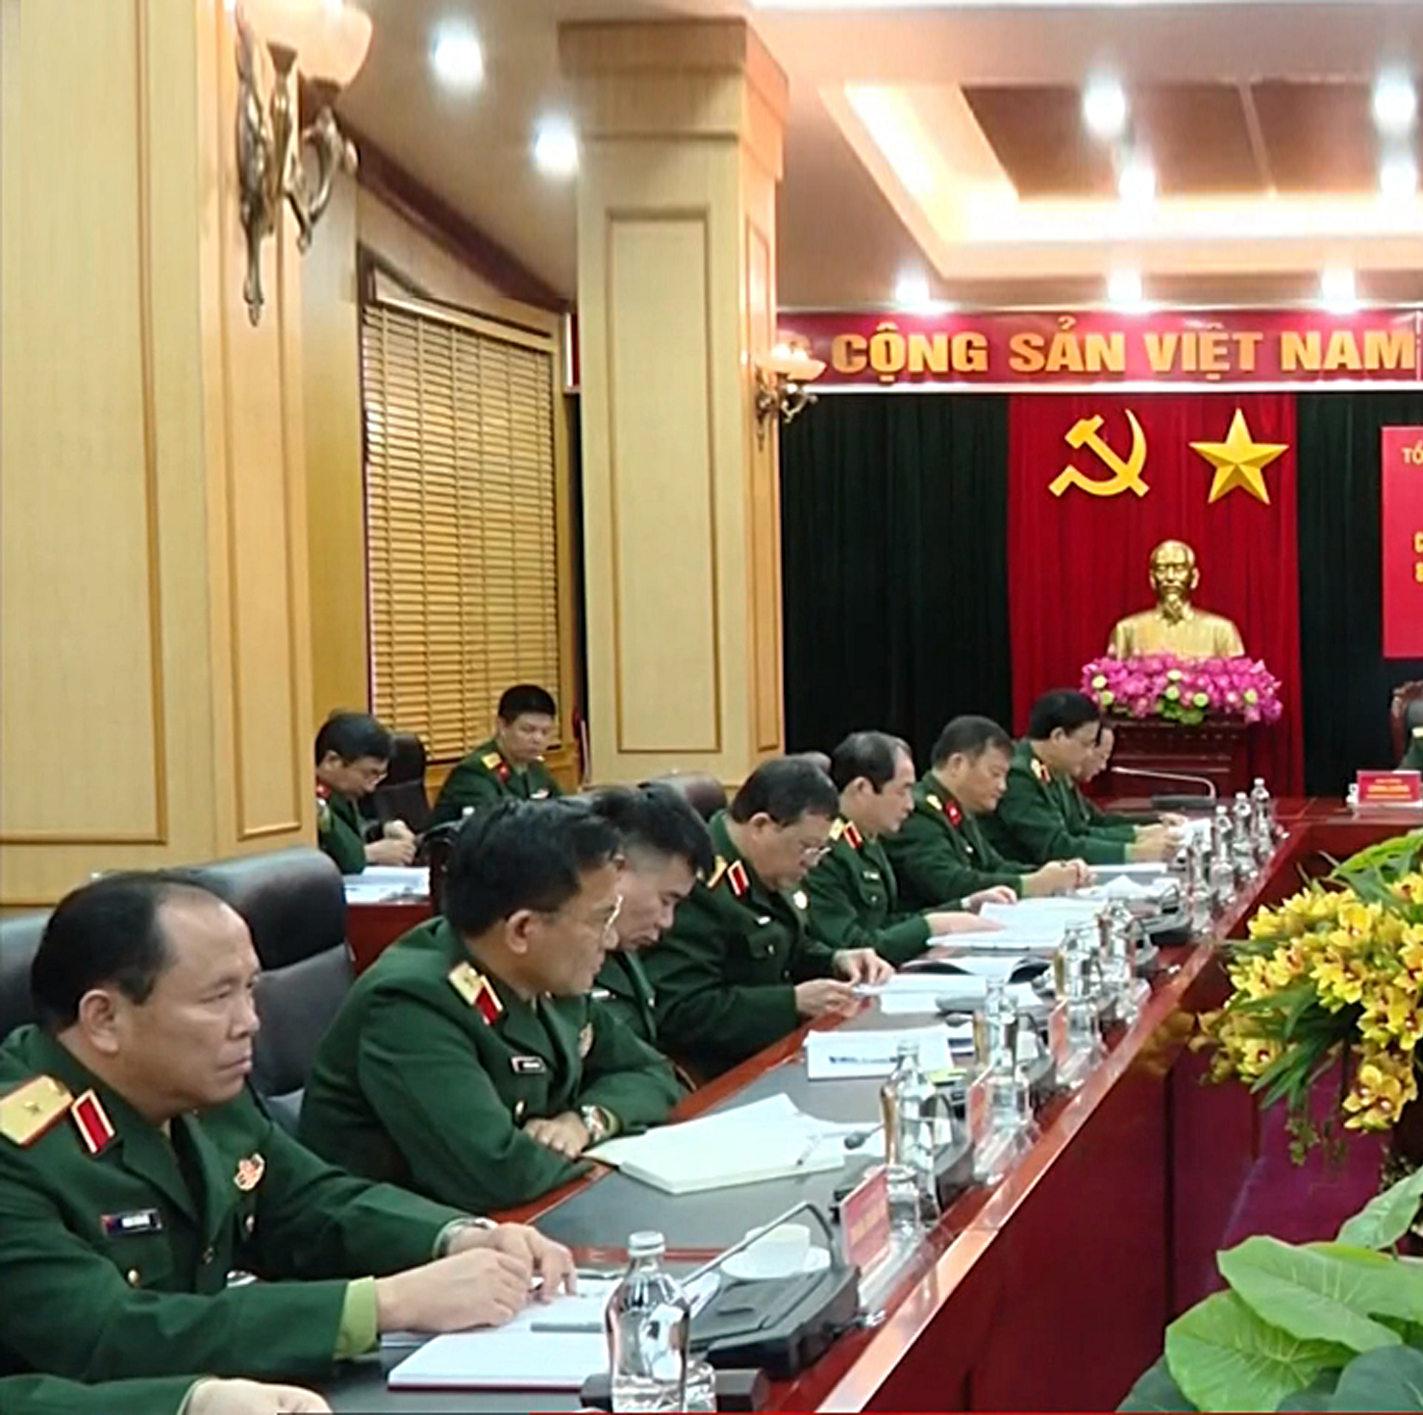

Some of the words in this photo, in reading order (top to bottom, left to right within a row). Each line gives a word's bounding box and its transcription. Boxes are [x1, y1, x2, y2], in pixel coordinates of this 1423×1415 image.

[831, 321, 989, 382] CỘNG
[1009, 316, 1125, 373] SẢN
[1144, 321, 1263, 380] VIỆT
[1281, 331, 1416, 371] NAM
